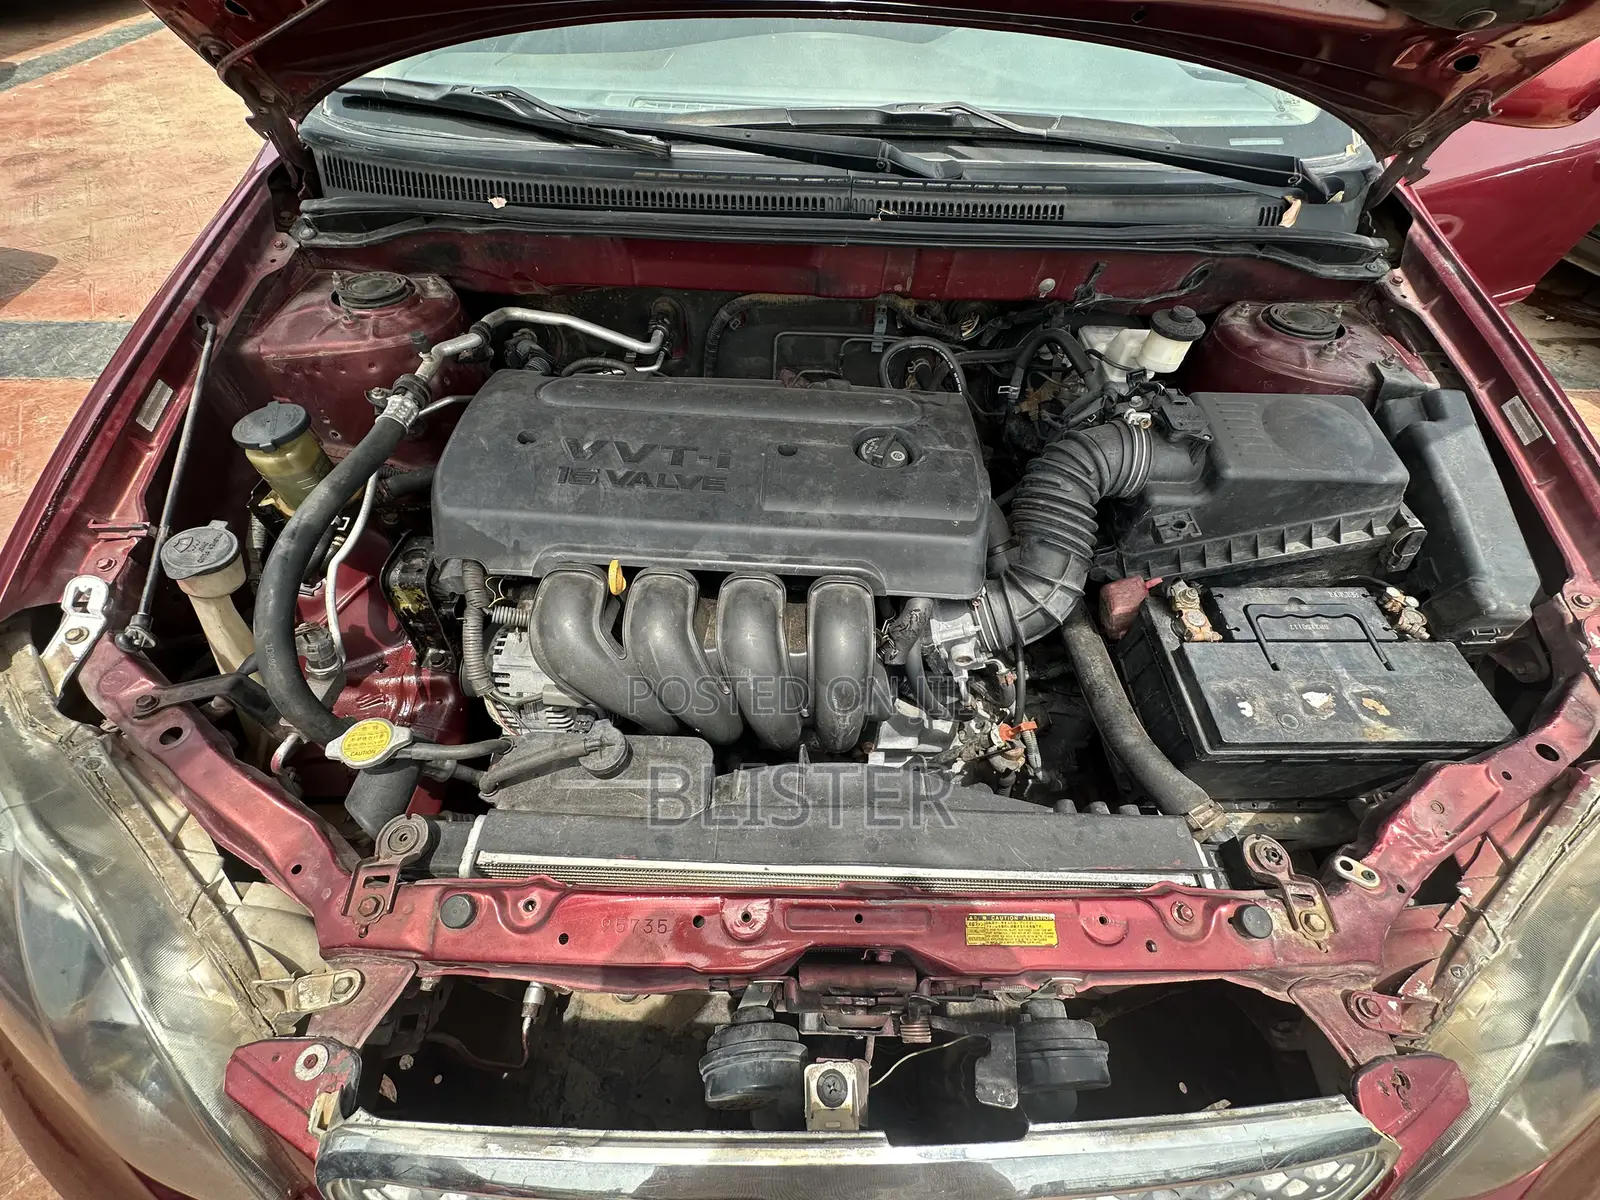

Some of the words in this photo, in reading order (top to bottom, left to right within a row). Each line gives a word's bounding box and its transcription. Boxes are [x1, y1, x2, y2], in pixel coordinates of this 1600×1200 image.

[561, 436, 731, 470] VVT-i
[605, 469, 728, 493] VALVE
[350, 749, 377, 757] CAUTION
